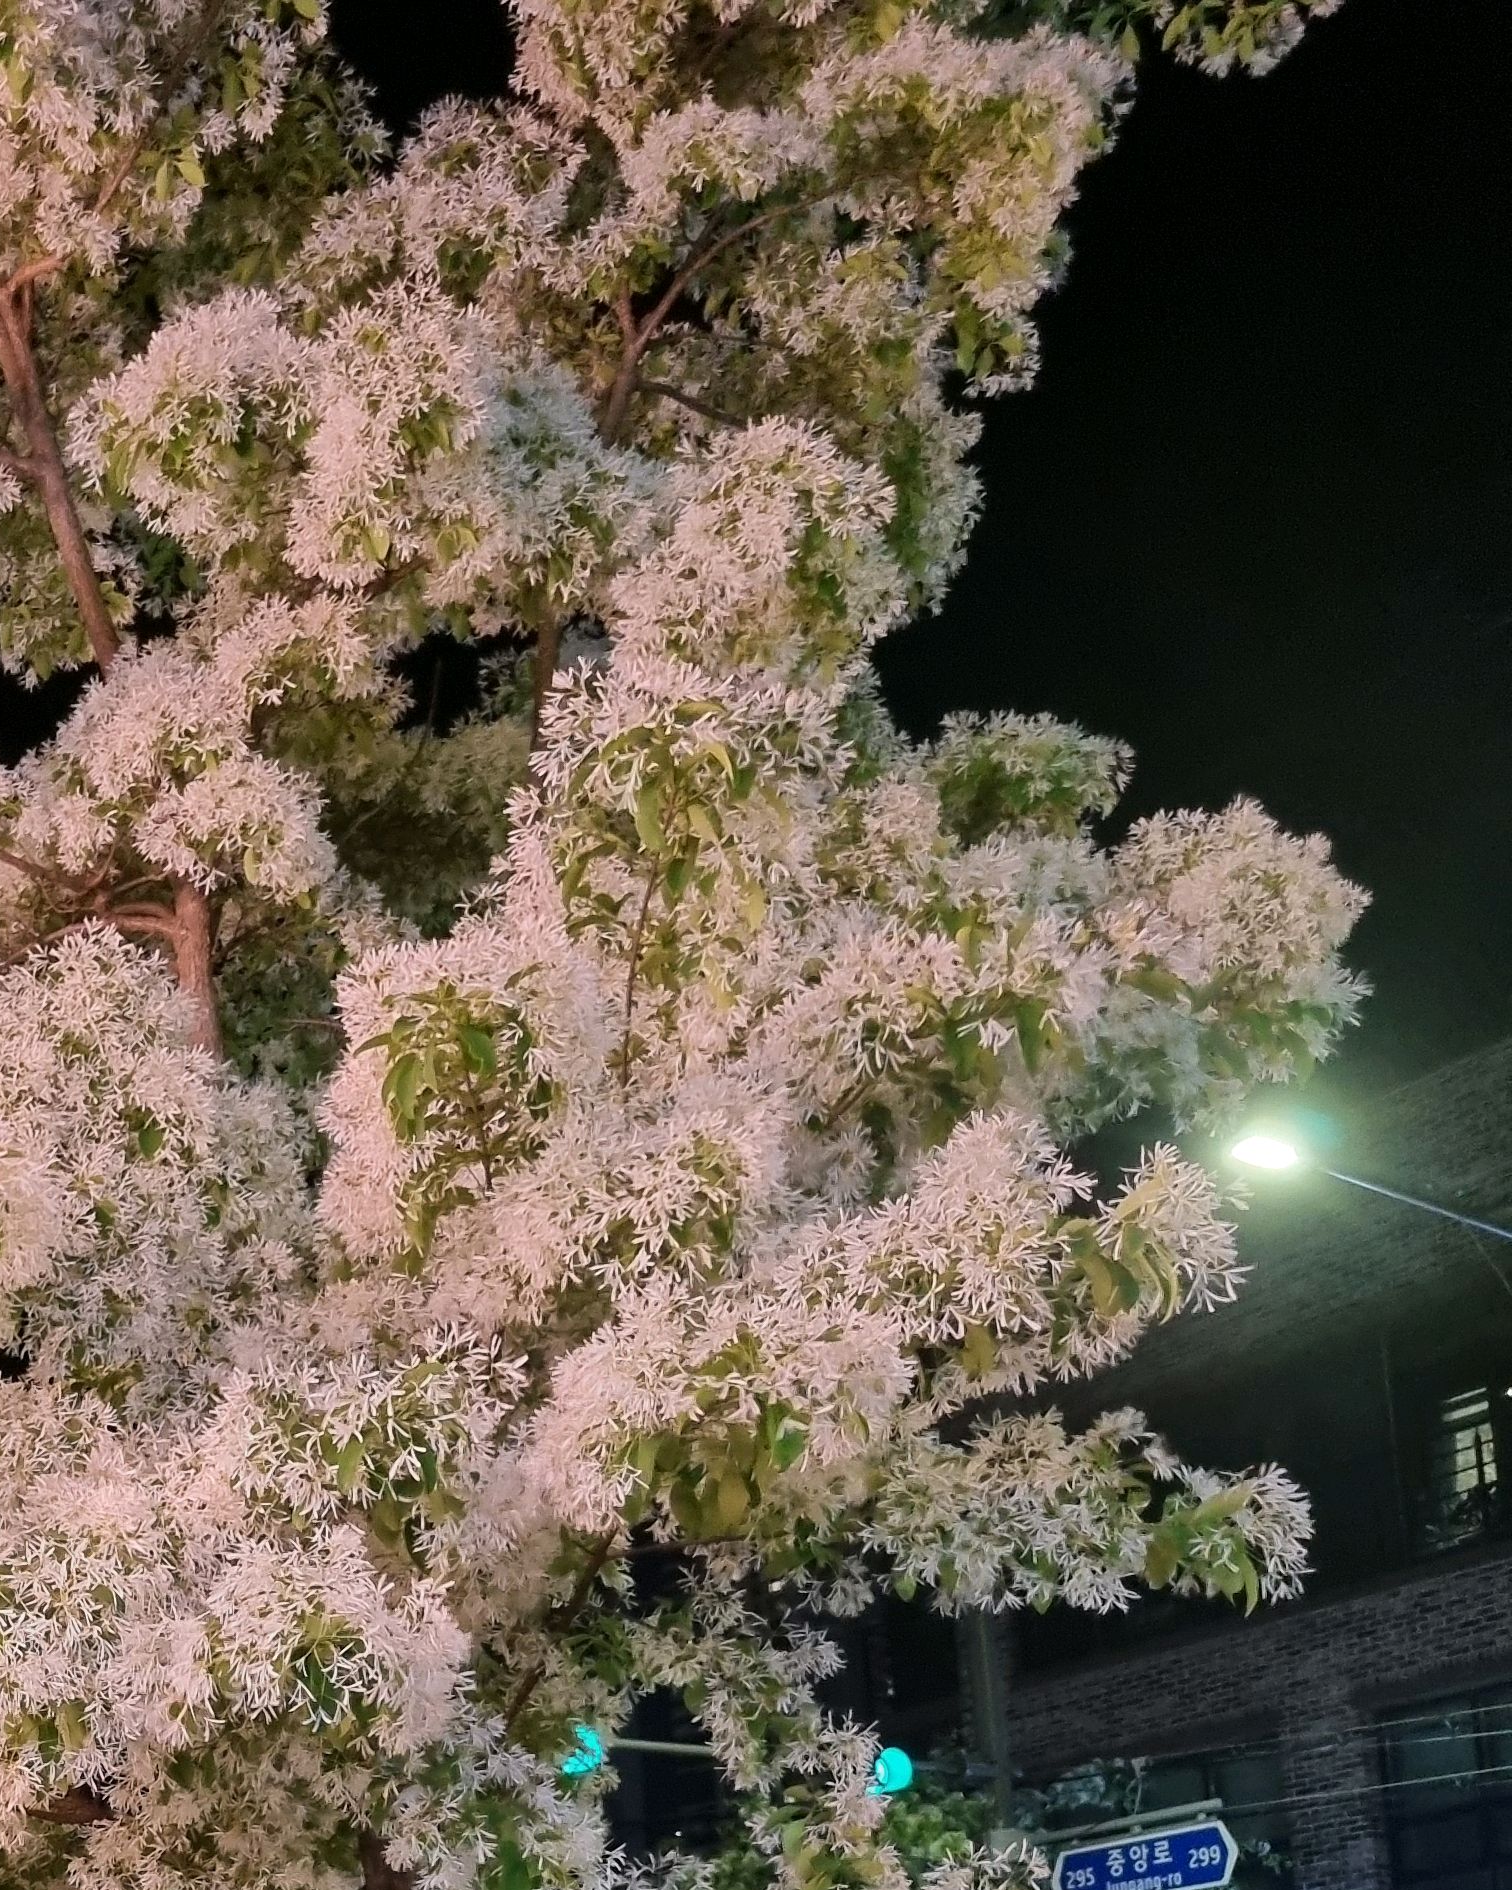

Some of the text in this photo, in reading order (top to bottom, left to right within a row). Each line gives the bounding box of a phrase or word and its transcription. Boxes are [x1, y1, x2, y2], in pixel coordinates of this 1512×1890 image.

[1066, 1840, 1221, 1889] 295 중앙로 299
